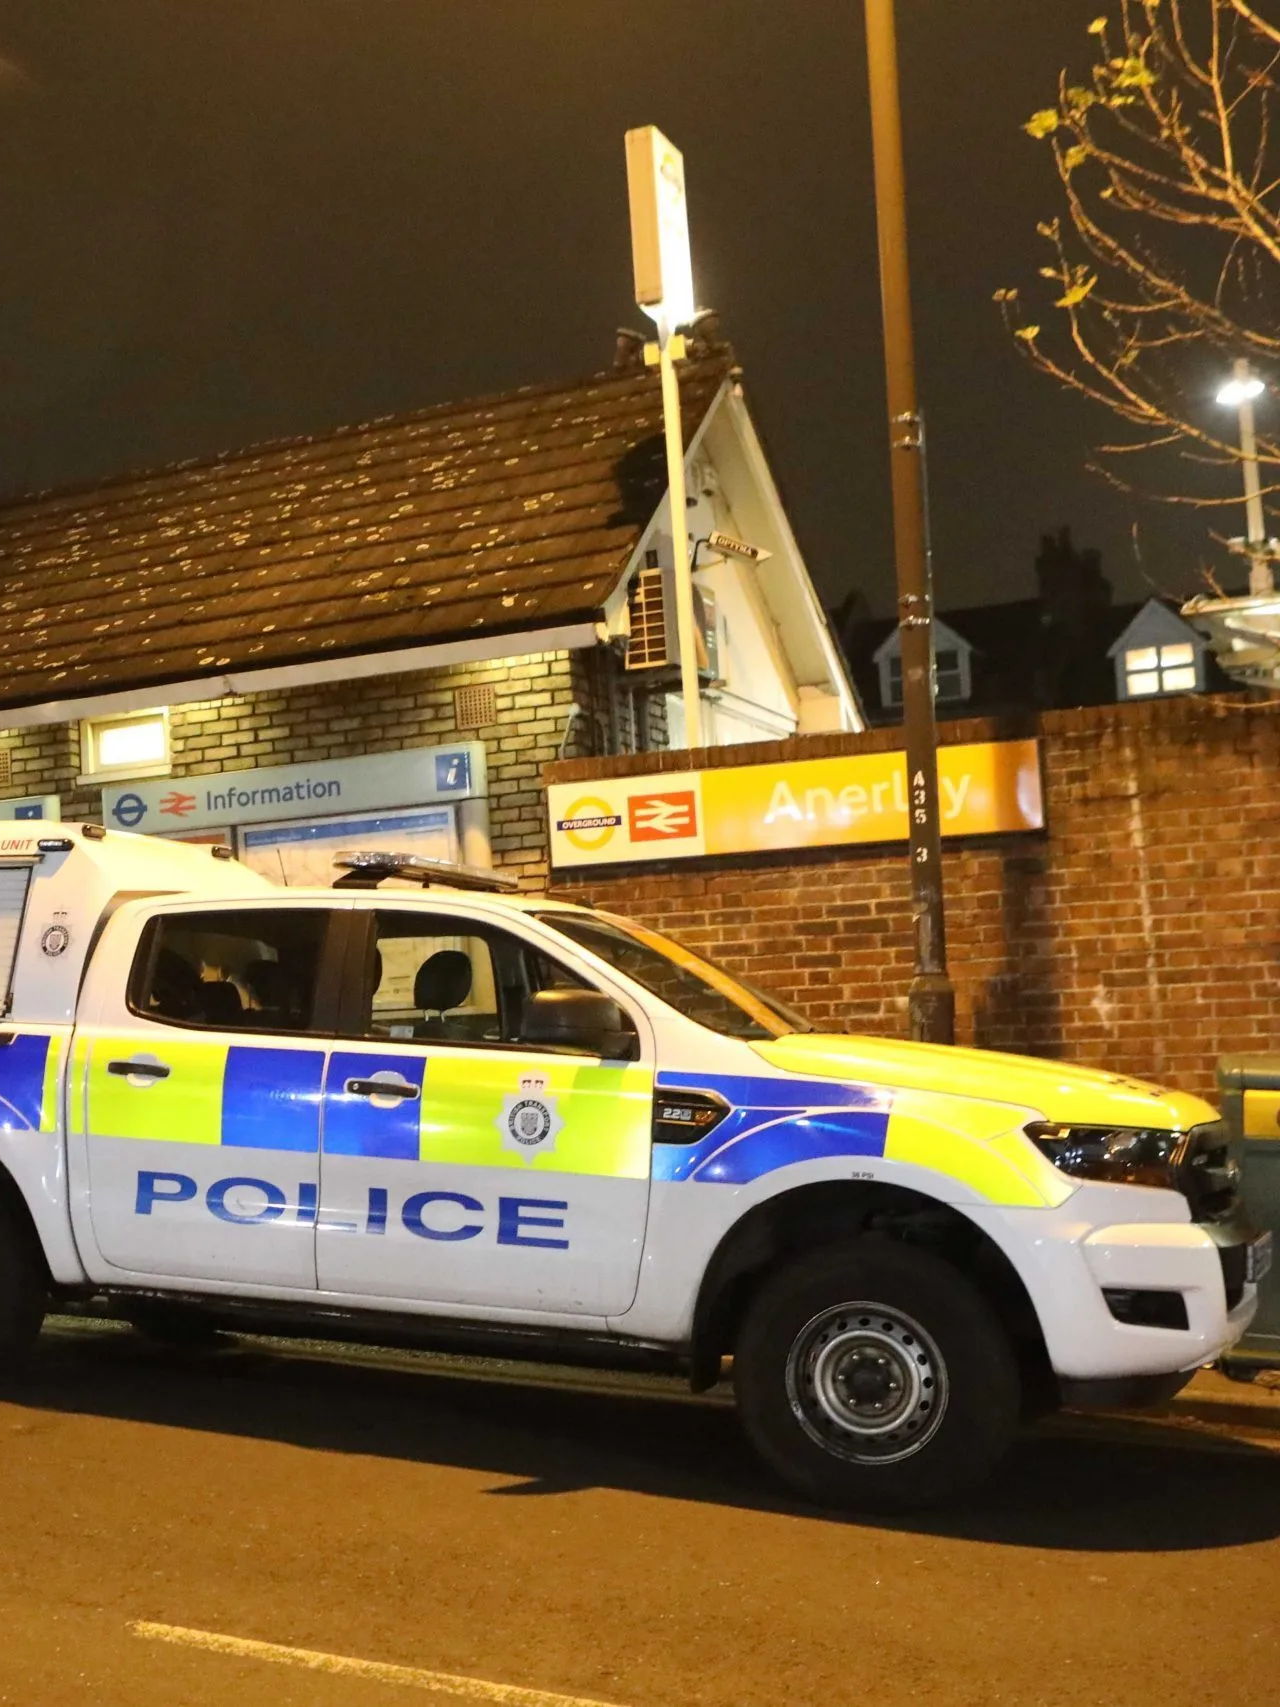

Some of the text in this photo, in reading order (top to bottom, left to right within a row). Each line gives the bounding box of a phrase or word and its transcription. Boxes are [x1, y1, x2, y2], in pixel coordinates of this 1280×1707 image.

[206, 777, 341, 811] Information
[763, 773, 971, 824] Anerly
[562, 817, 617, 830] OVERGROUND
[1, 839, 34, 851] UNIT
[135, 1170, 570, 1249] POLICE
